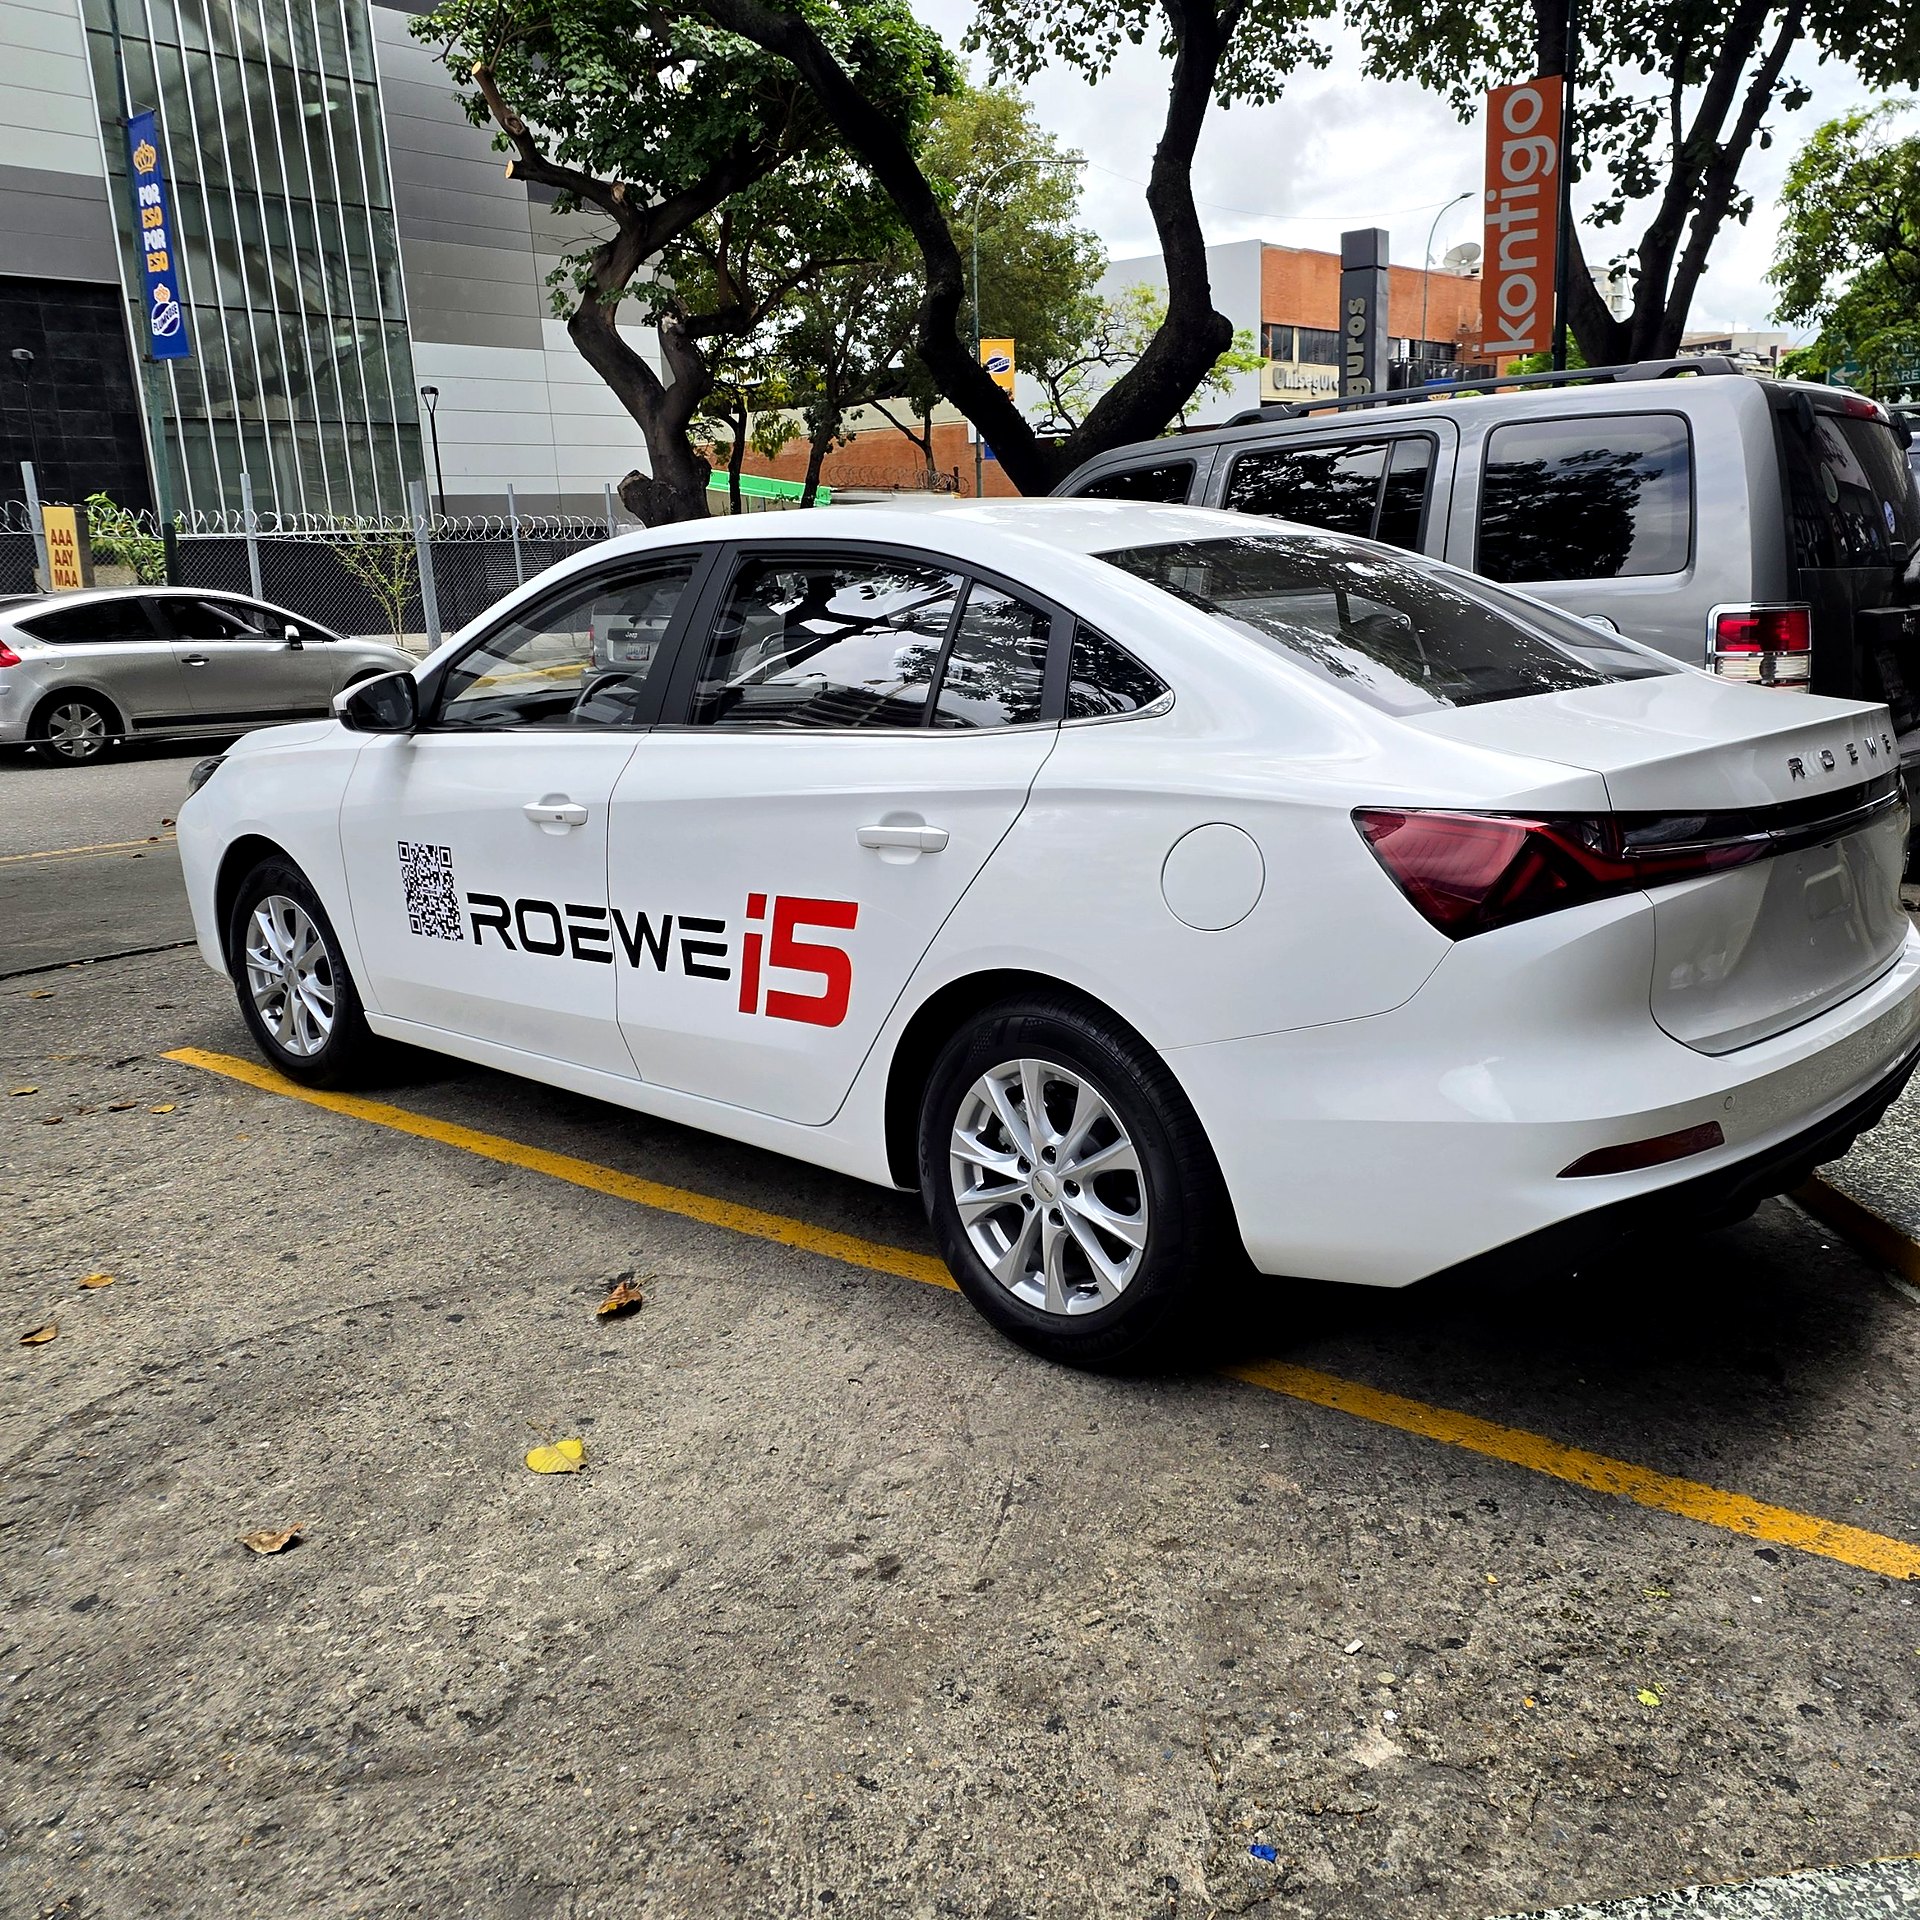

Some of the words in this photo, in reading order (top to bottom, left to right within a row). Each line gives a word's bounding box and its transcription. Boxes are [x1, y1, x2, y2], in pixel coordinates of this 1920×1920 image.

[138, 183, 161, 207] POR
[141, 205, 163, 229] ESO
[1484, 87, 1556, 353] kontigo
[143, 228, 167, 251] POR
[146, 250, 169, 273] ESO
[51, 528, 74, 546] AAA
[54, 549, 73, 567] AAY
[54, 569, 79, 588] MAA
[1787, 733, 1892, 782] ROEWE
[466, 892, 731, 981] ROEWE
[738, 893, 859, 1028] i5
